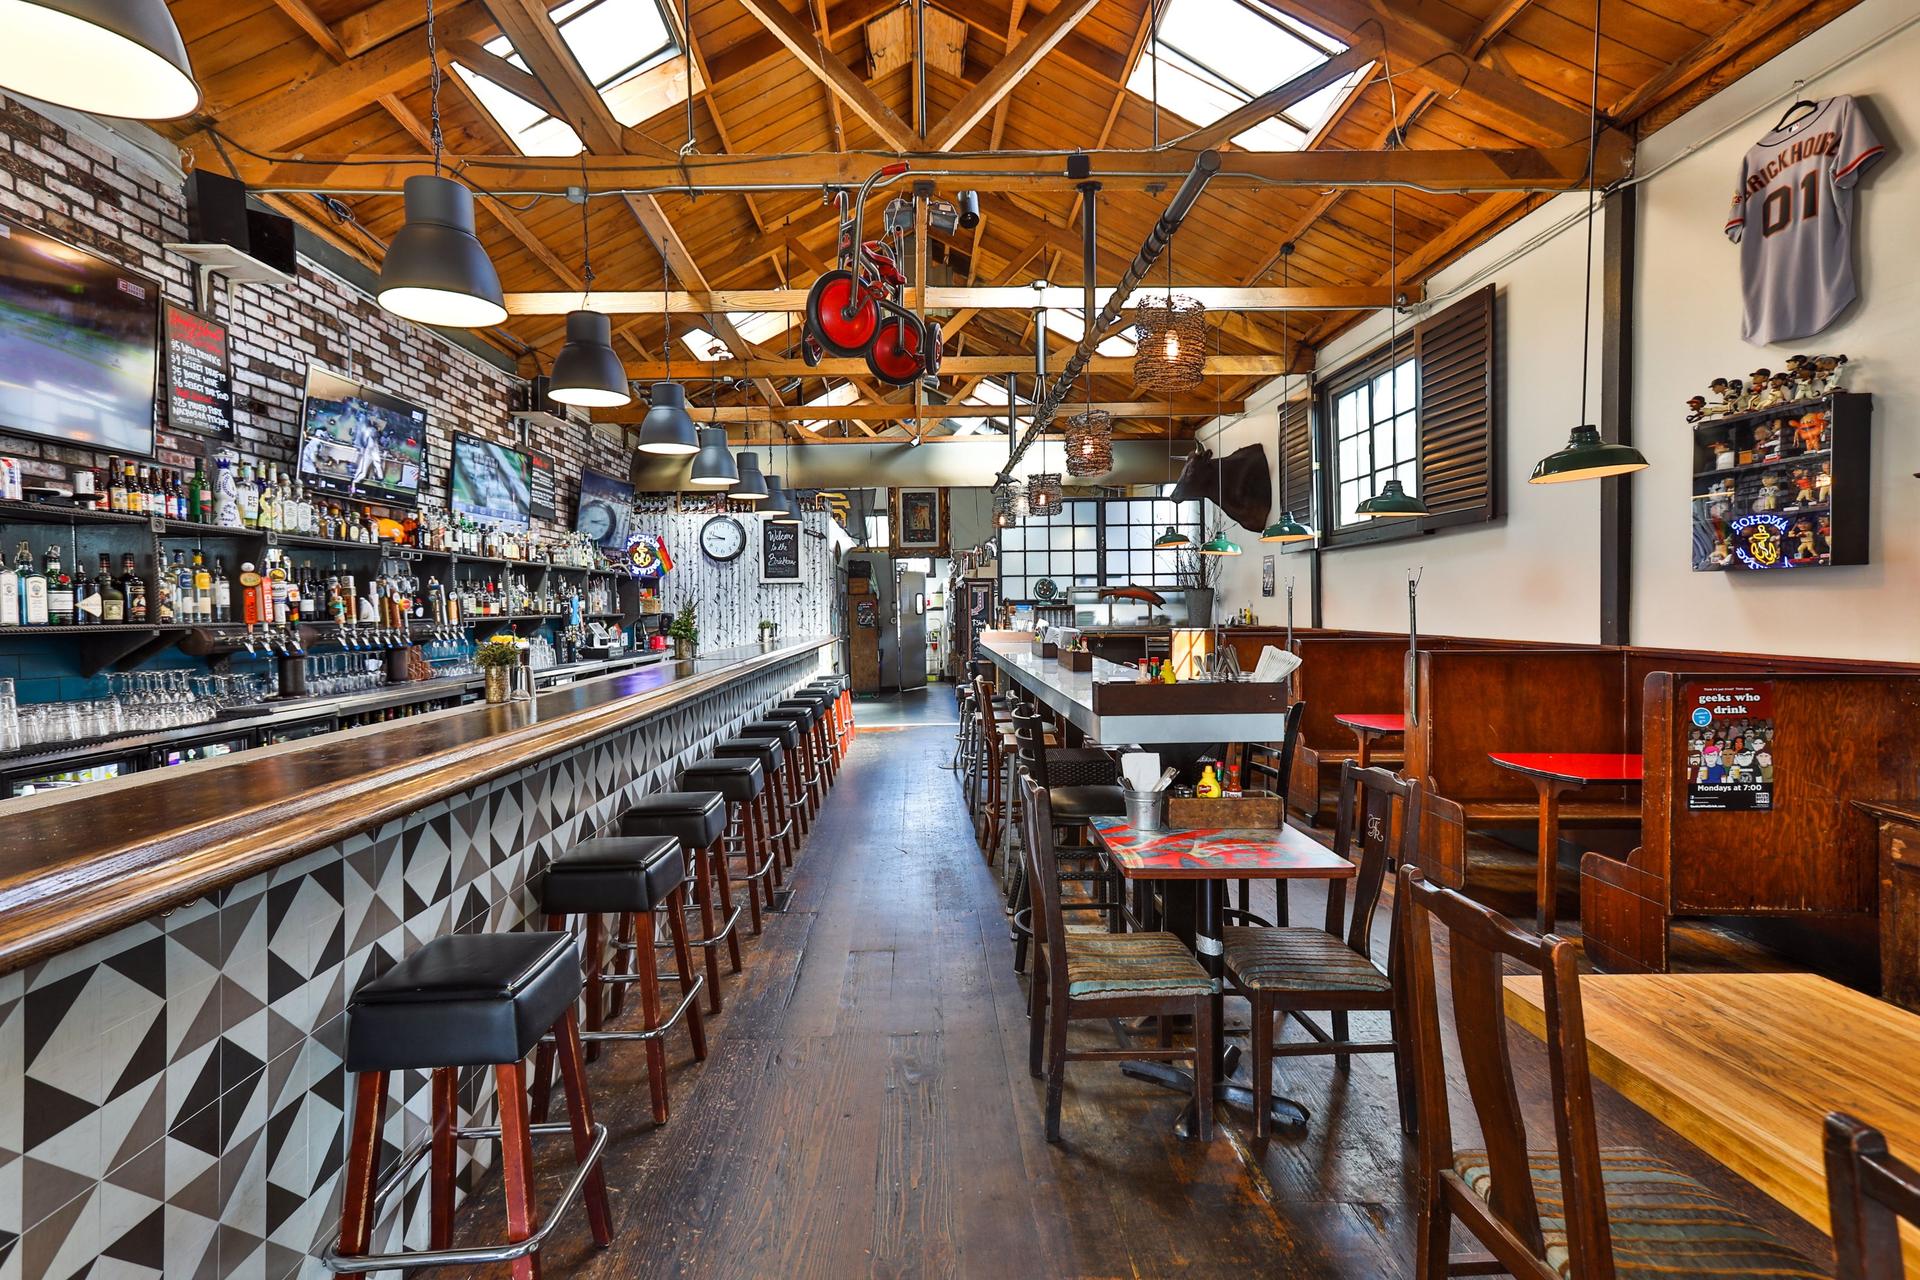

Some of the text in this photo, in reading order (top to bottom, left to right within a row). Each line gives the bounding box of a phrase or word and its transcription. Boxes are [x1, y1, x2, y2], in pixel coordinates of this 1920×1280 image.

[1762, 168, 1820, 239] 01
[767, 529, 794, 542] Welcome
[1698, 692, 1761, 704] geeks who
[1713, 705, 1747, 714] drink
[1697, 784, 1731, 793] Mondays
